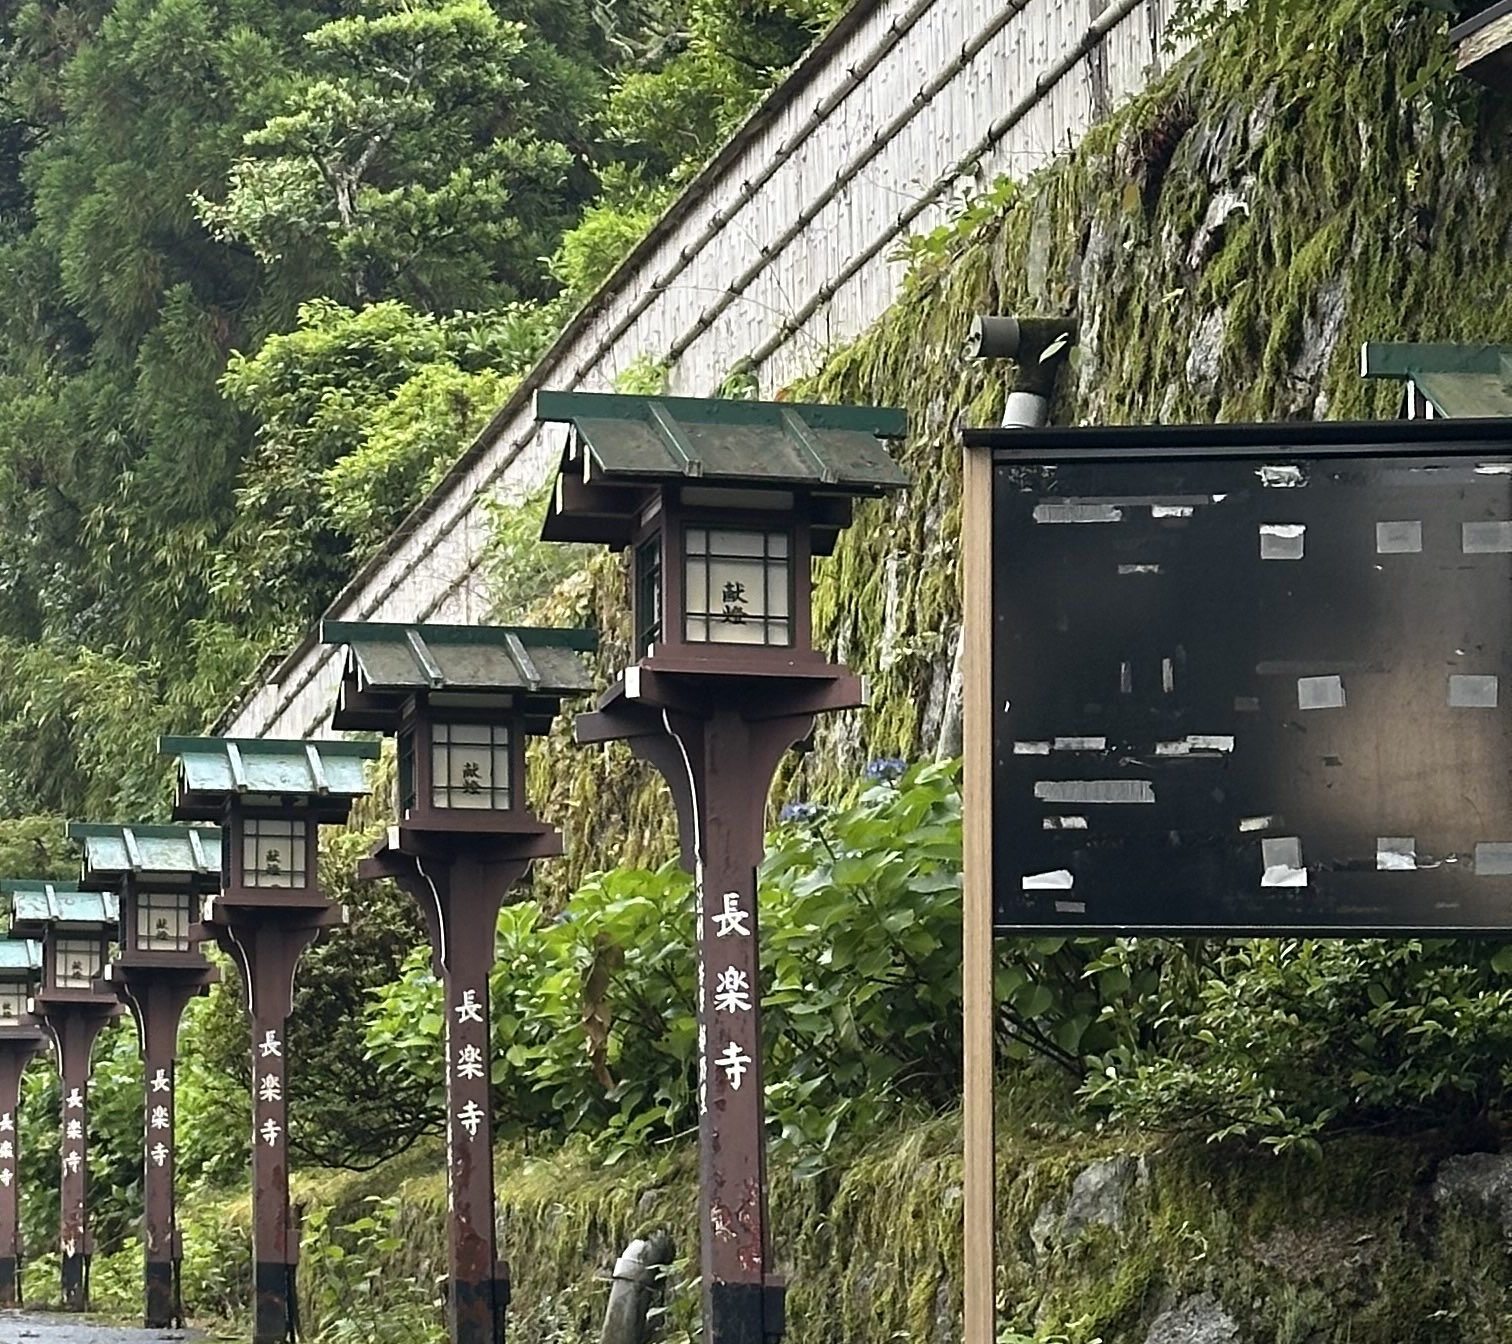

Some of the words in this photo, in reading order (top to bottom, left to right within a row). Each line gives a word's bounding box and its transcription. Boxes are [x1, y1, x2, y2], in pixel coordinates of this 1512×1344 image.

[711, 891, 753, 1092] 長楽寺
[150, 1068, 170, 1167] 長楽寺
[258, 1029, 282, 1147] 長楽寺
[454, 989, 485, 1136] 長楽寺
